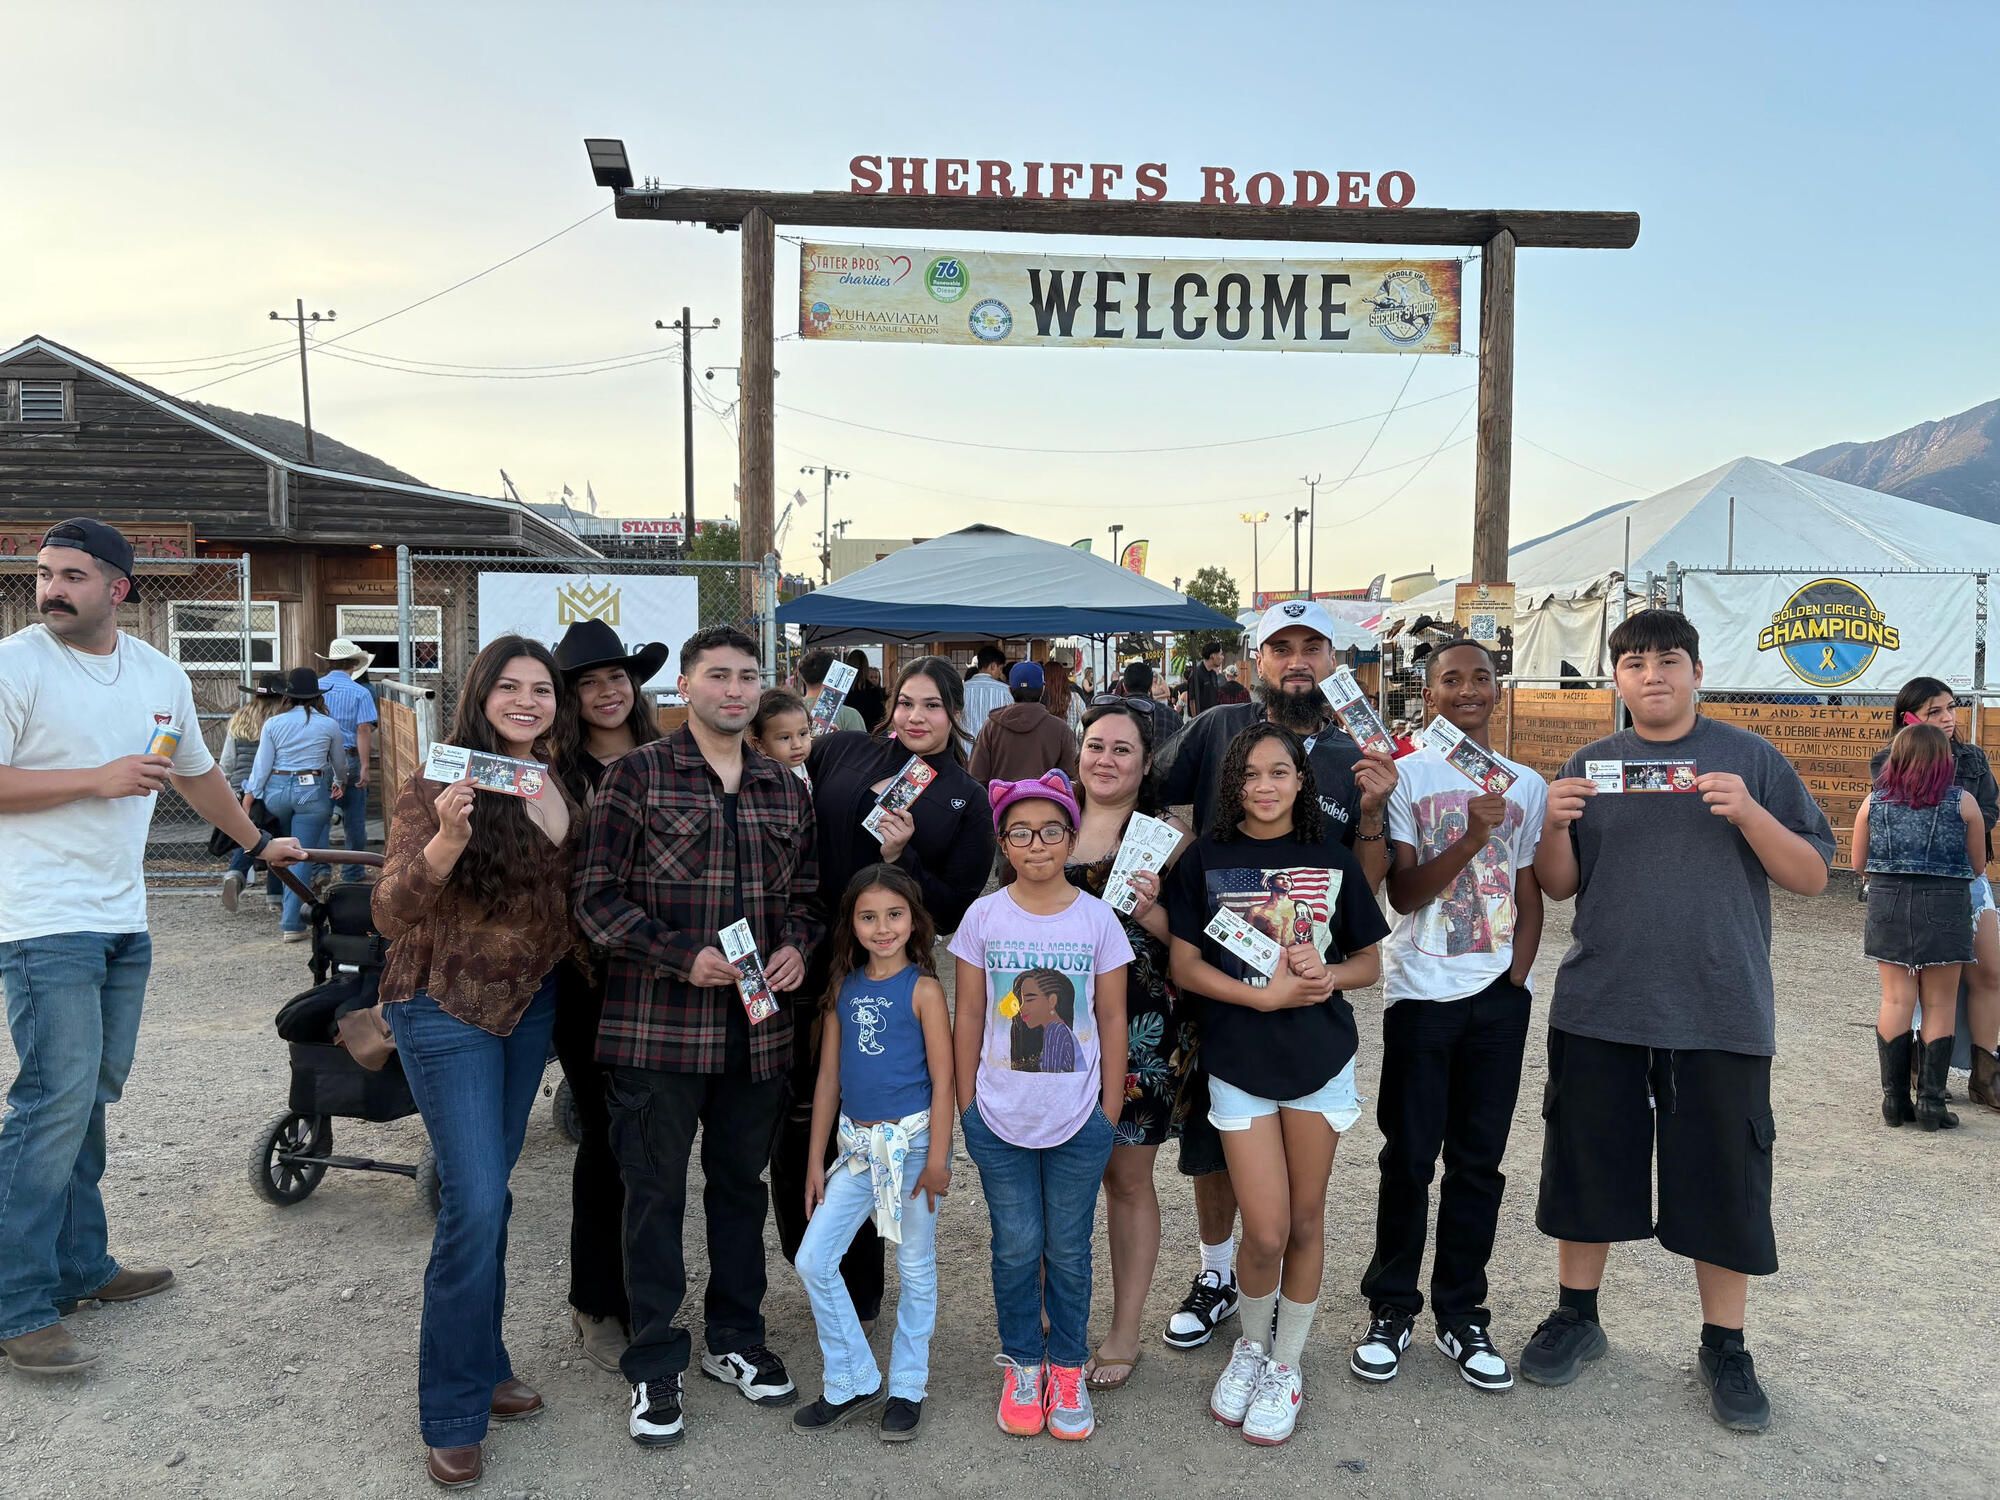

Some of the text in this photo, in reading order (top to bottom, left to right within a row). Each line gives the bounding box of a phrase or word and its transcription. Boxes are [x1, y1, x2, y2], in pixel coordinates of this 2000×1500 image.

[1200, 166, 1416, 209] RODEO
[810, 254, 881, 272] STATER BROS.
[936, 259, 959, 279] 76
[839, 272, 892, 287] charities
[1387, 270, 1424, 280] SADDLE UP
[1027, 267, 1351, 341] WELCOME
[1413, 300, 1438, 317] RODEO
[835, 308, 939, 325] YUHAAVIATAM
[835, 322, 939, 335] OF SAN MANUEL NATION
[621, 520, 684, 534] STATER
[356, 583, 385, 592] WILL
[1772, 603, 1886, 625] GOLDEN CIRCLE OF
[1758, 617, 1900, 652] CHAMPIONS
[1535, 692, 1588, 700] UNION PACIFIC
[1731, 706, 1893, 721] TIM AND JETTA WE
[1747, 724, 1772, 736] DAVE
[1774, 725, 1782, 736] &
[1784, 725, 1820, 738] DEBBIE
[1823, 727, 1855, 739] JAYNE
[1868, 729, 1892, 740] FAM
[1794, 743, 1838, 756] FAMILY'S
[1810, 779, 1874, 793] SILVERSM
[1003, 940, 1025, 951] ARE
[1028, 941, 1044, 952] ALL
[985, 950, 1095, 972] STARDUST
[849, 995, 875, 1007] Rodeo
